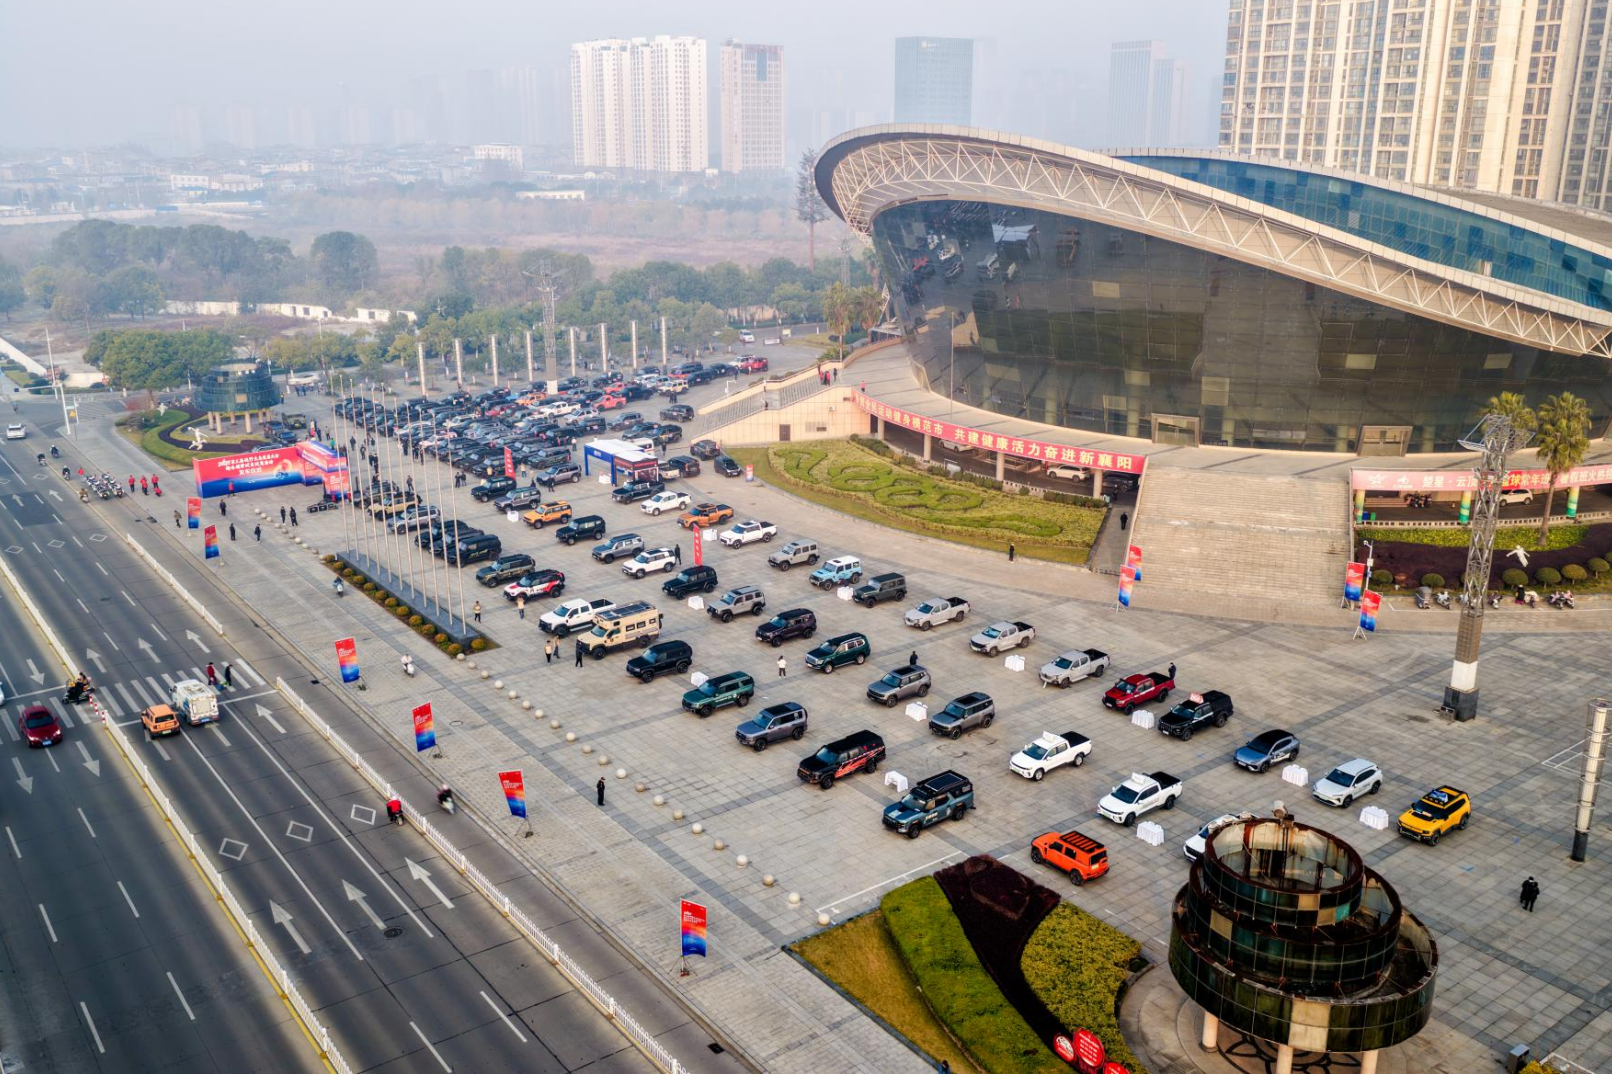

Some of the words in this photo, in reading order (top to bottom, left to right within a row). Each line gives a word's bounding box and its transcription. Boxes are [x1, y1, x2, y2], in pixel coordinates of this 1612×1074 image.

[954, 428, 1133, 470] 共建健康活力奋进新襄阳
